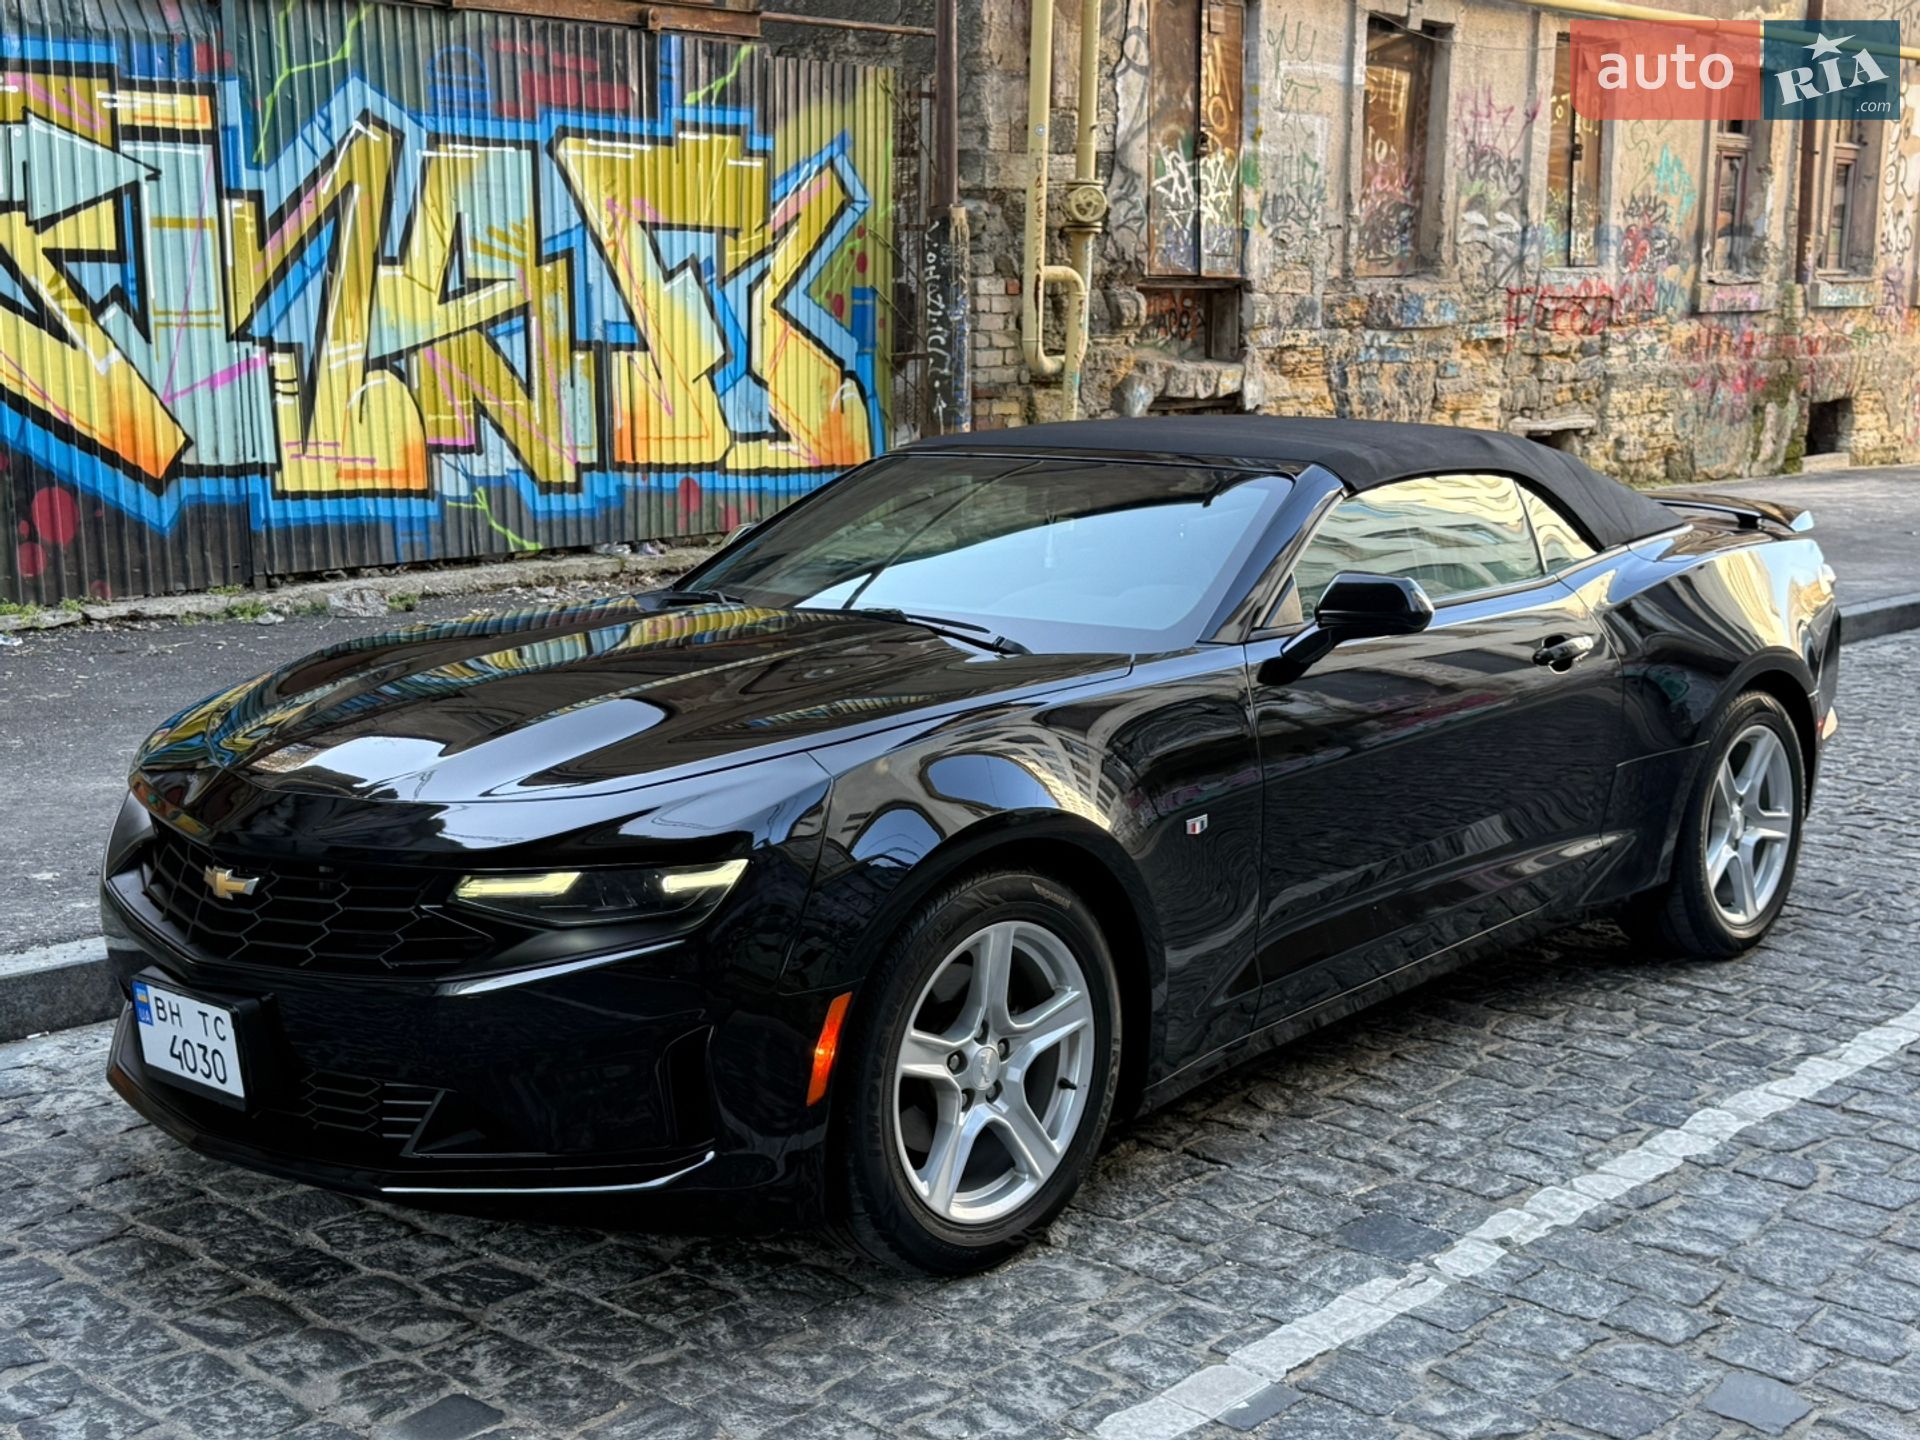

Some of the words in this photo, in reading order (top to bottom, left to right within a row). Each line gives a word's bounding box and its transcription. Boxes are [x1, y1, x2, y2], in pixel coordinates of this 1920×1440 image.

[154, 996, 183, 1028] BH
[198, 1010, 227, 1041] TC
[169, 1035, 228, 1085] 4030
